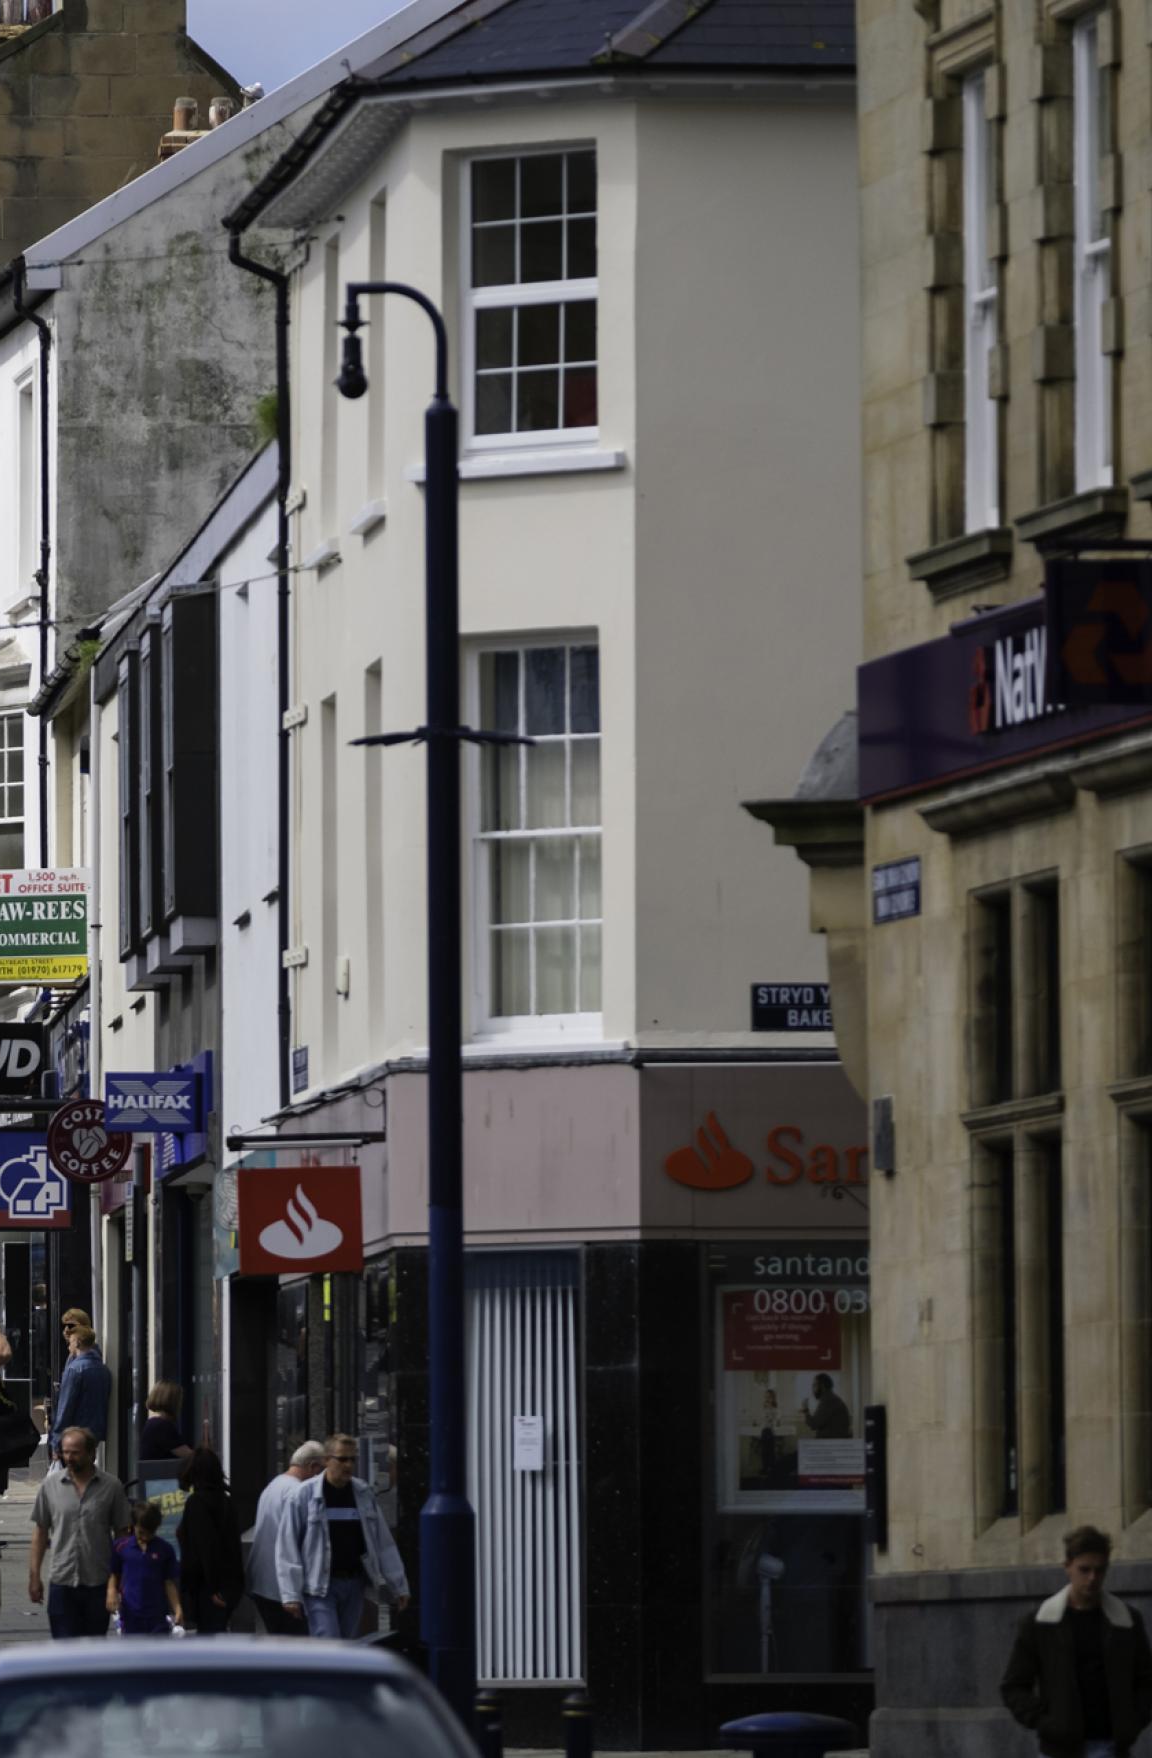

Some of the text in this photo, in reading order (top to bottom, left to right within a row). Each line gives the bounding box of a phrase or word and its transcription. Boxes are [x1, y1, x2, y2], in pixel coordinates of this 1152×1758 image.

[18, 883, 85, 893] OFFICE SUITE
[32, 957, 54, 965] STREET
[18, 966, 49, 975] (01970)
[52, 965, 82, 974] 617179
[757, 987, 814, 1005] STRYD
[108, 1095, 191, 1110] HALIFAX
[59, 1147, 121, 1176] COFFEE
[754, 1289, 825, 1314] 0800
